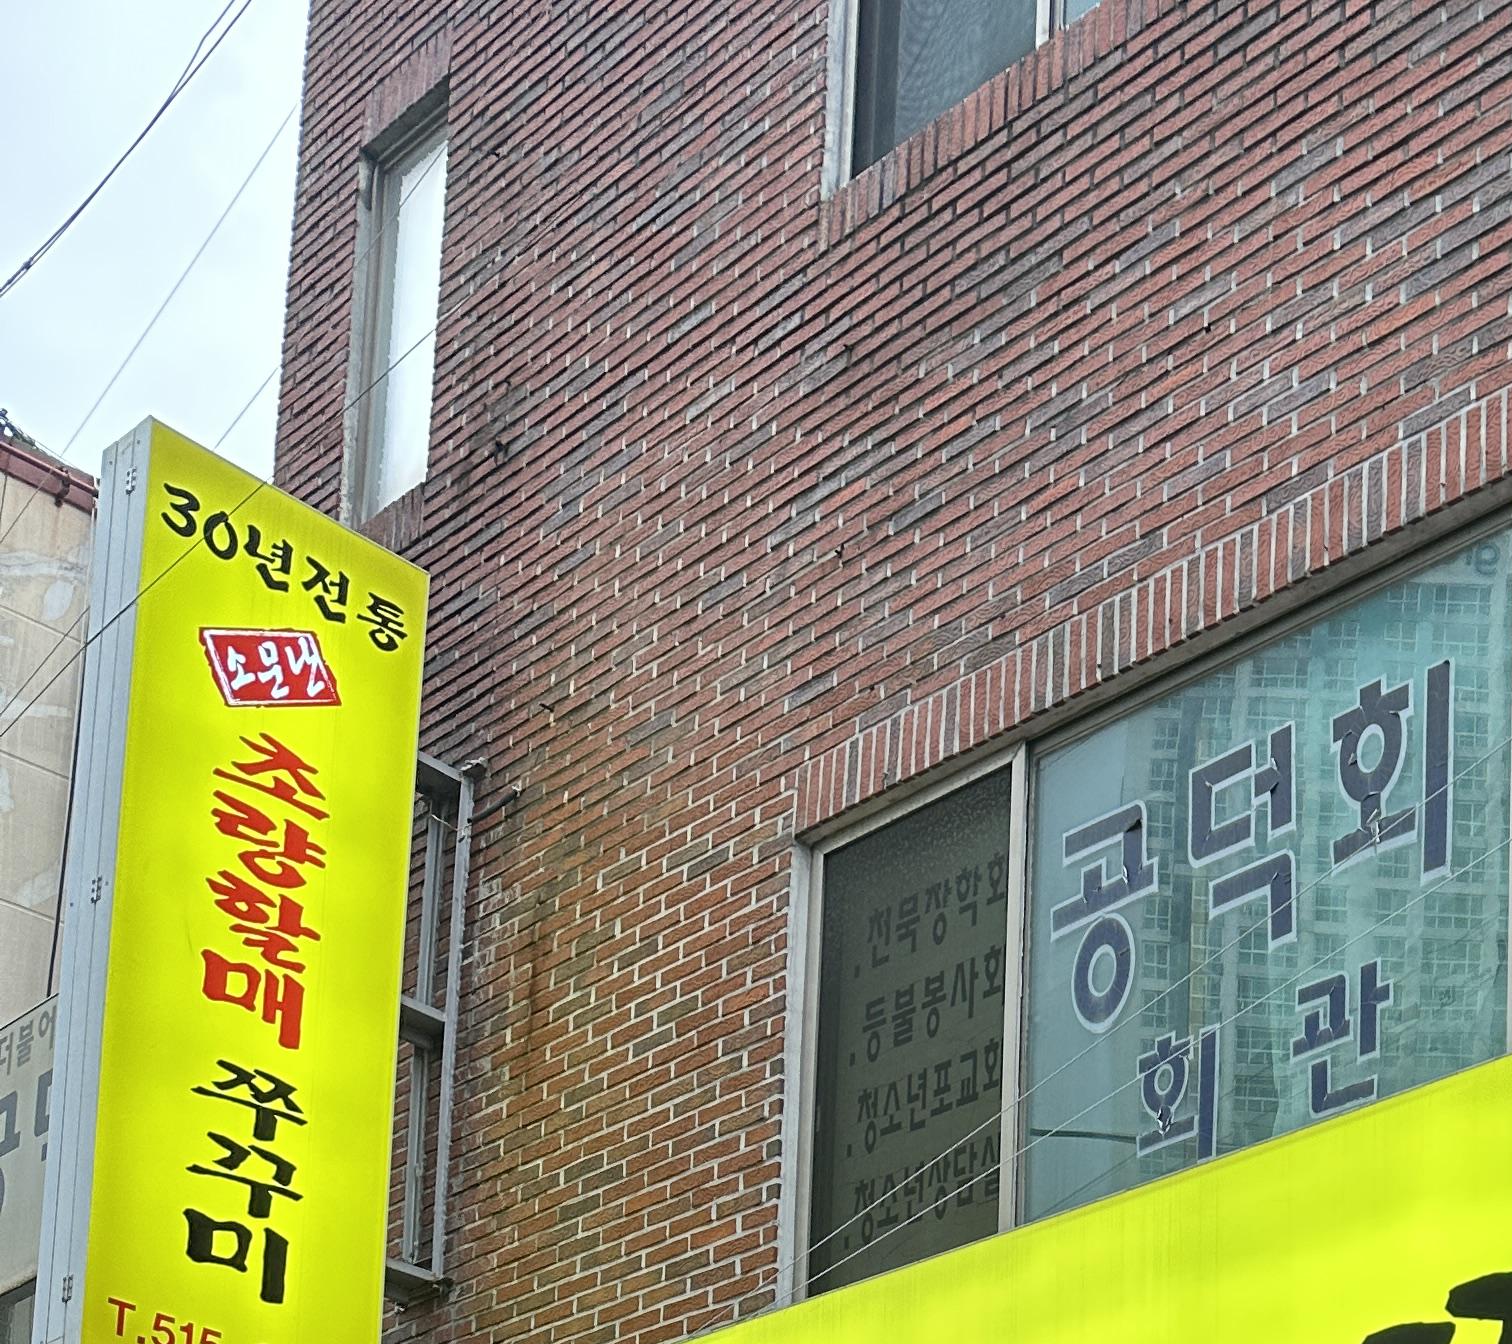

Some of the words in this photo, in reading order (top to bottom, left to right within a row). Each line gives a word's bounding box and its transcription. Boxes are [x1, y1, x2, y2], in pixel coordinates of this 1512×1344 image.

[161, 483, 408, 652] 30년전통
[201, 731, 331, 1050] 초량할매
[1050, 658, 1455, 1035] 공덕회
[182, 1059, 309, 1305] 쭈꾸미
[1136, 957, 1393, 1164] 회관
